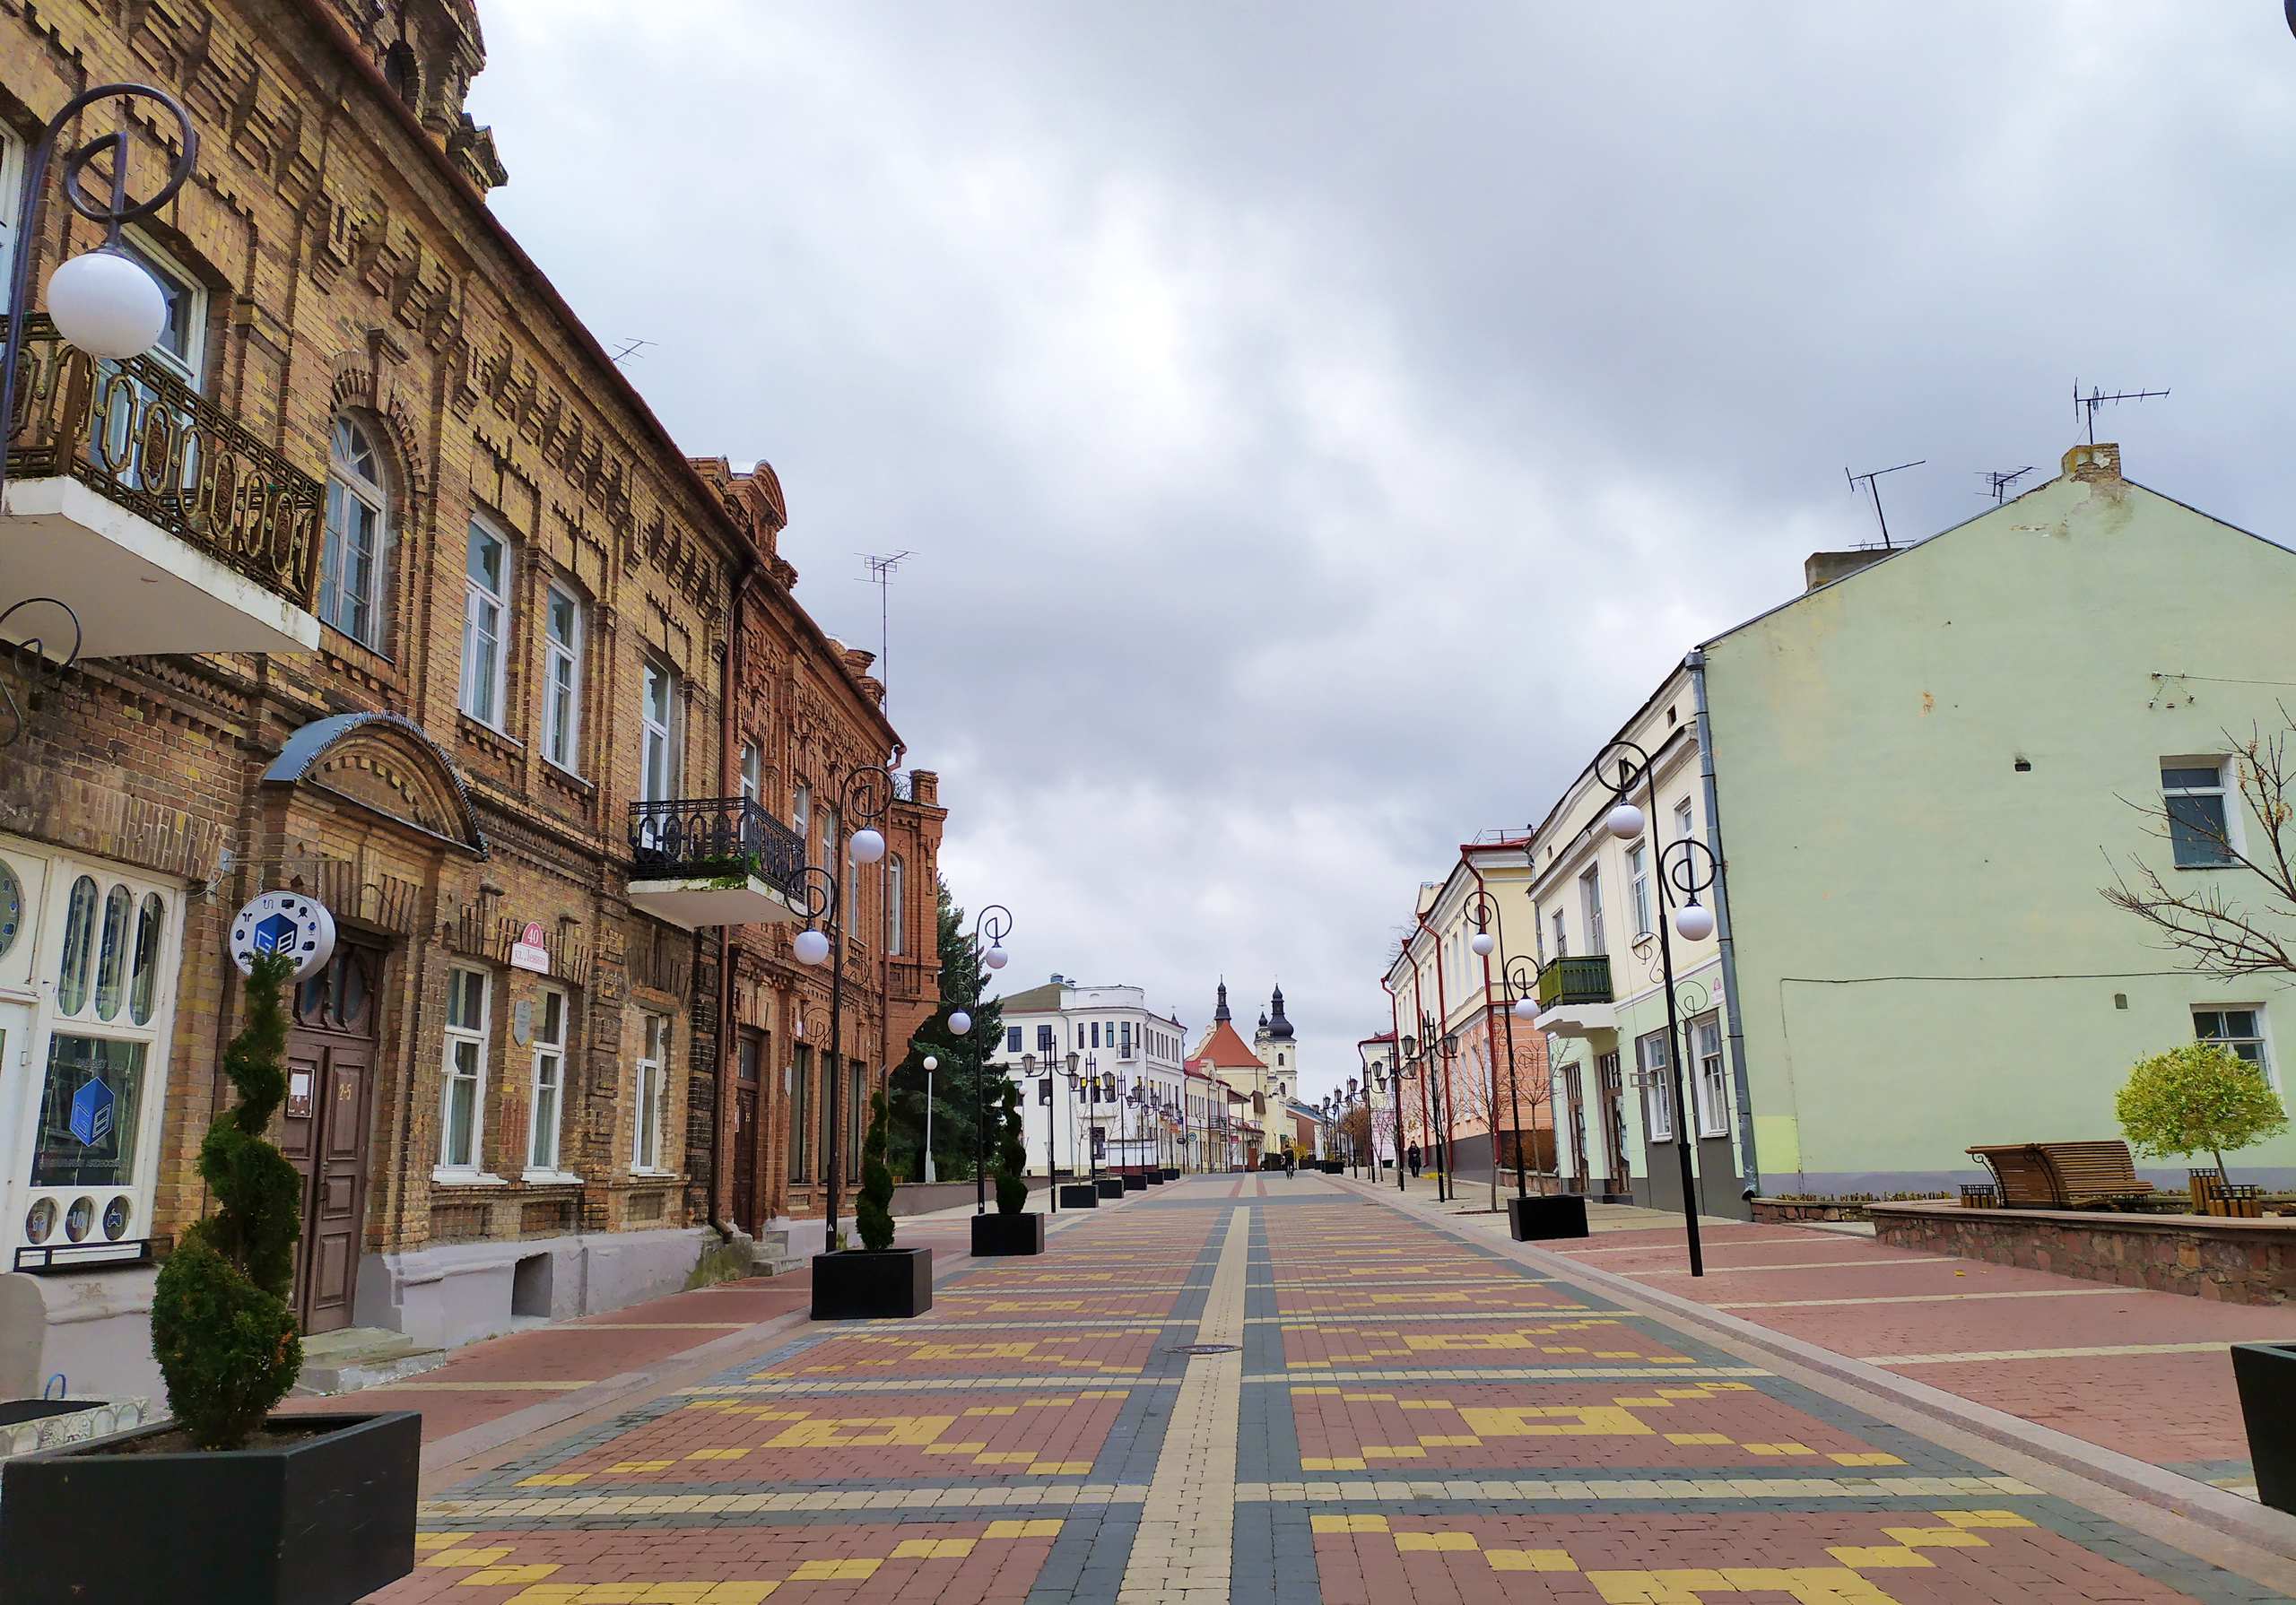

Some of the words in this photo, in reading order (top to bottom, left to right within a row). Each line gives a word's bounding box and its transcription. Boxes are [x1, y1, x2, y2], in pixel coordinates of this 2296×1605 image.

[527, 928, 539, 944] 40
[514, 950, 524, 961] ул.
[524, 949, 546, 966] Ленина
[339, 1083, 352, 1101] 2-5
[74, 1102, 111, 1139] GB
